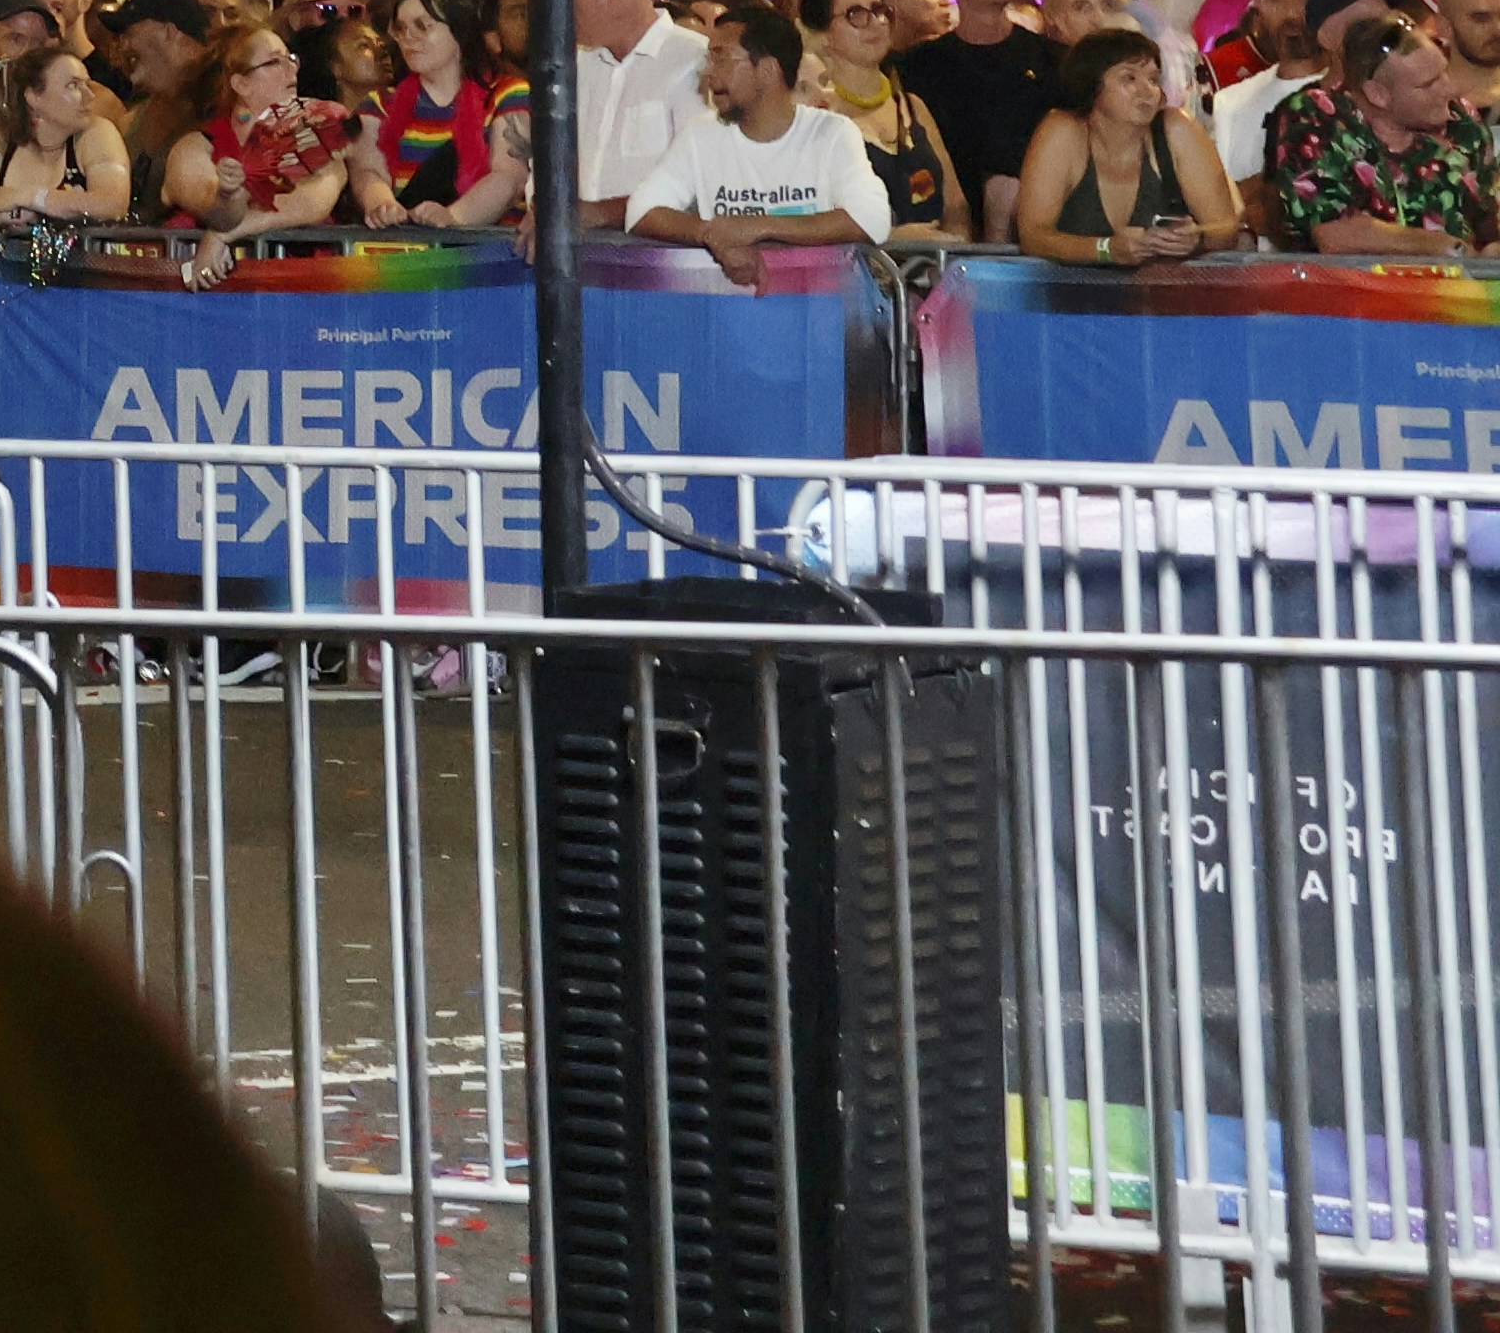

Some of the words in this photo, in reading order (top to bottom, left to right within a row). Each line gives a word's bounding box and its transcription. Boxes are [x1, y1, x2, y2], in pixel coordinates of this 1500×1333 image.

[714, 185, 818, 205] Australian
[316, 325, 388, 345] Principal
[392, 327, 453, 344] Partner
[89, 364, 683, 452] AMERICN
